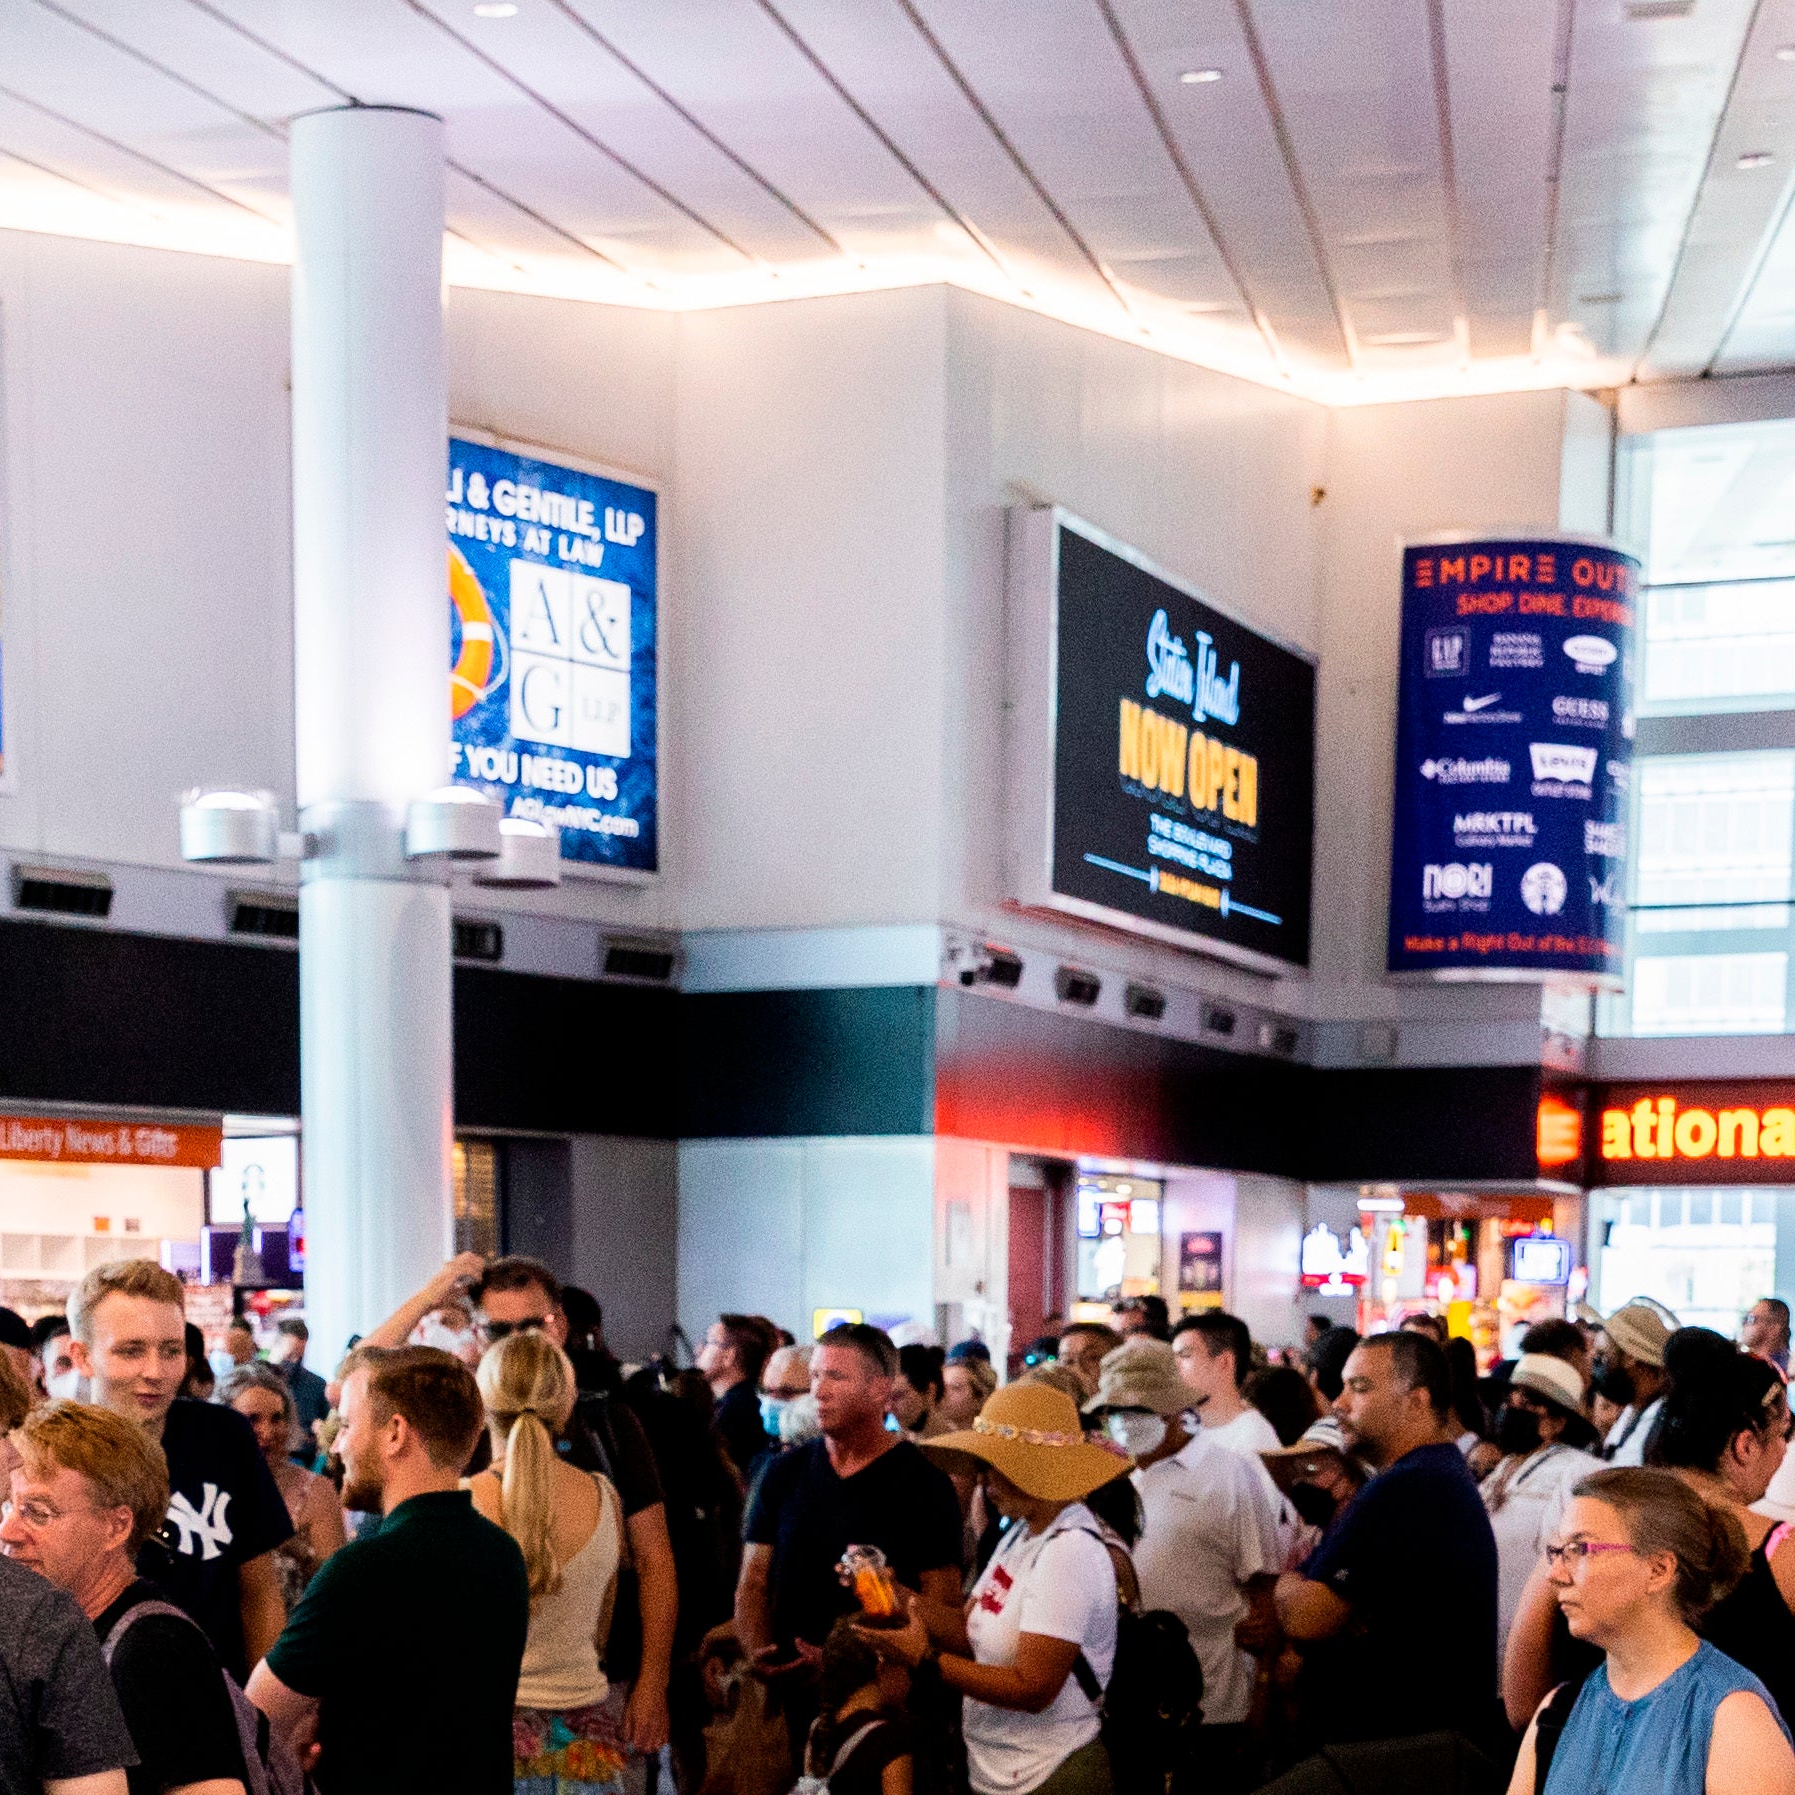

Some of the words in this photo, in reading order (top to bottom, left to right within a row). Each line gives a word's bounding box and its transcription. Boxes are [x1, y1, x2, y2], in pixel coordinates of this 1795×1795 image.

[467, 471, 491, 511] &
[492, 479, 601, 542] GENTILE,
[604, 506, 645, 547] LLP
[522, 527, 552, 556] AT
[557, 534, 605, 569] LAW
[1414, 553, 1555, 589] EMPIRE
[1456, 591, 1514, 616] SHOP
[464, 744, 520, 785] YOU
[520, 753, 585, 795] NEED
[585, 765, 619, 801] US
[1119, 697, 1188, 798] NOW
[1188, 730, 1258, 828] OPEN
[65, 1124, 115, 1155] News
[116, 1128, 132, 1155] &
[133, 1128, 179, 1158] Gifts
